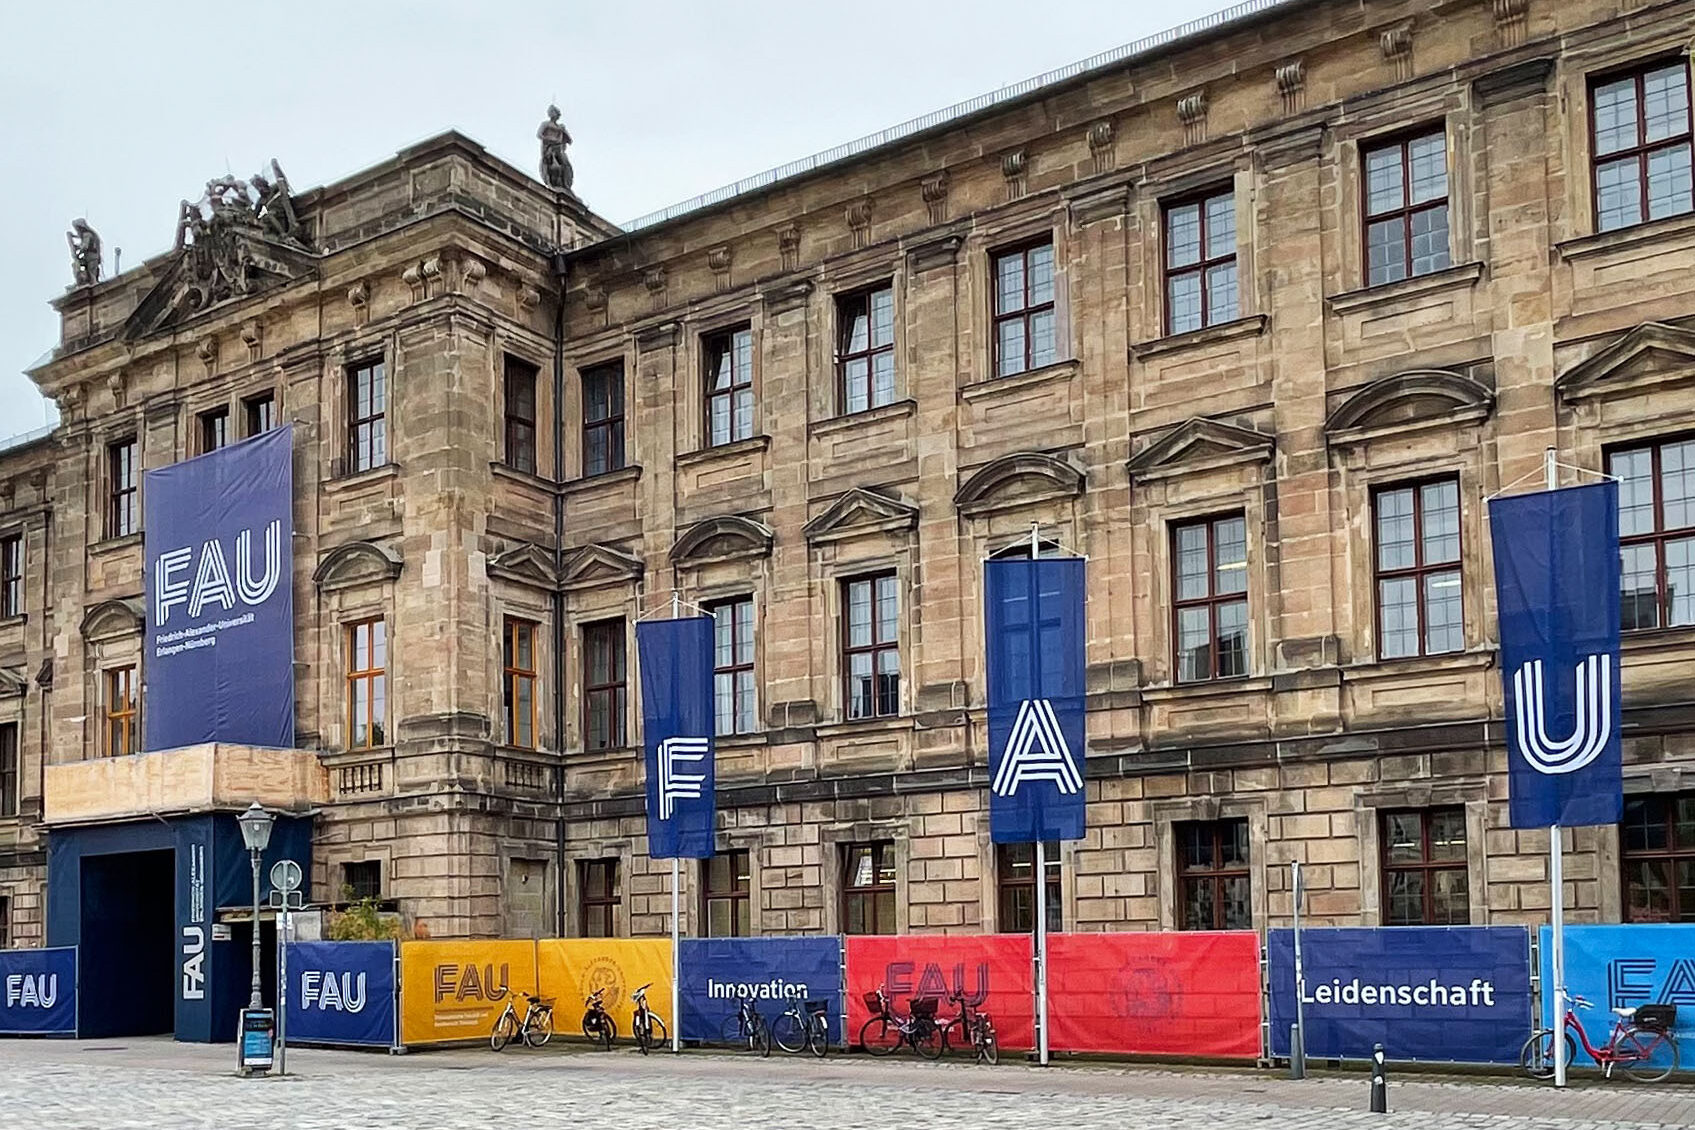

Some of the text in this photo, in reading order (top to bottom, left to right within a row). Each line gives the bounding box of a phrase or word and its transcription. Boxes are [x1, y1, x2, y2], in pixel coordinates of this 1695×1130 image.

[155, 519, 281, 627] FAU
[1514, 653, 1611, 774] U
[992, 699, 1084, 797] A
[658, 737, 708, 820] F
[183, 926, 205, 1000] FAU
[434, 963, 509, 1003] FAU
[886, 962, 989, 1007] FAU
[6, 973, 57, 1008] FAU
[301, 971, 366, 1013] FAU
[708, 978, 808, 999] Innovation
[1300, 979, 1495, 1006] Leidenschaft
